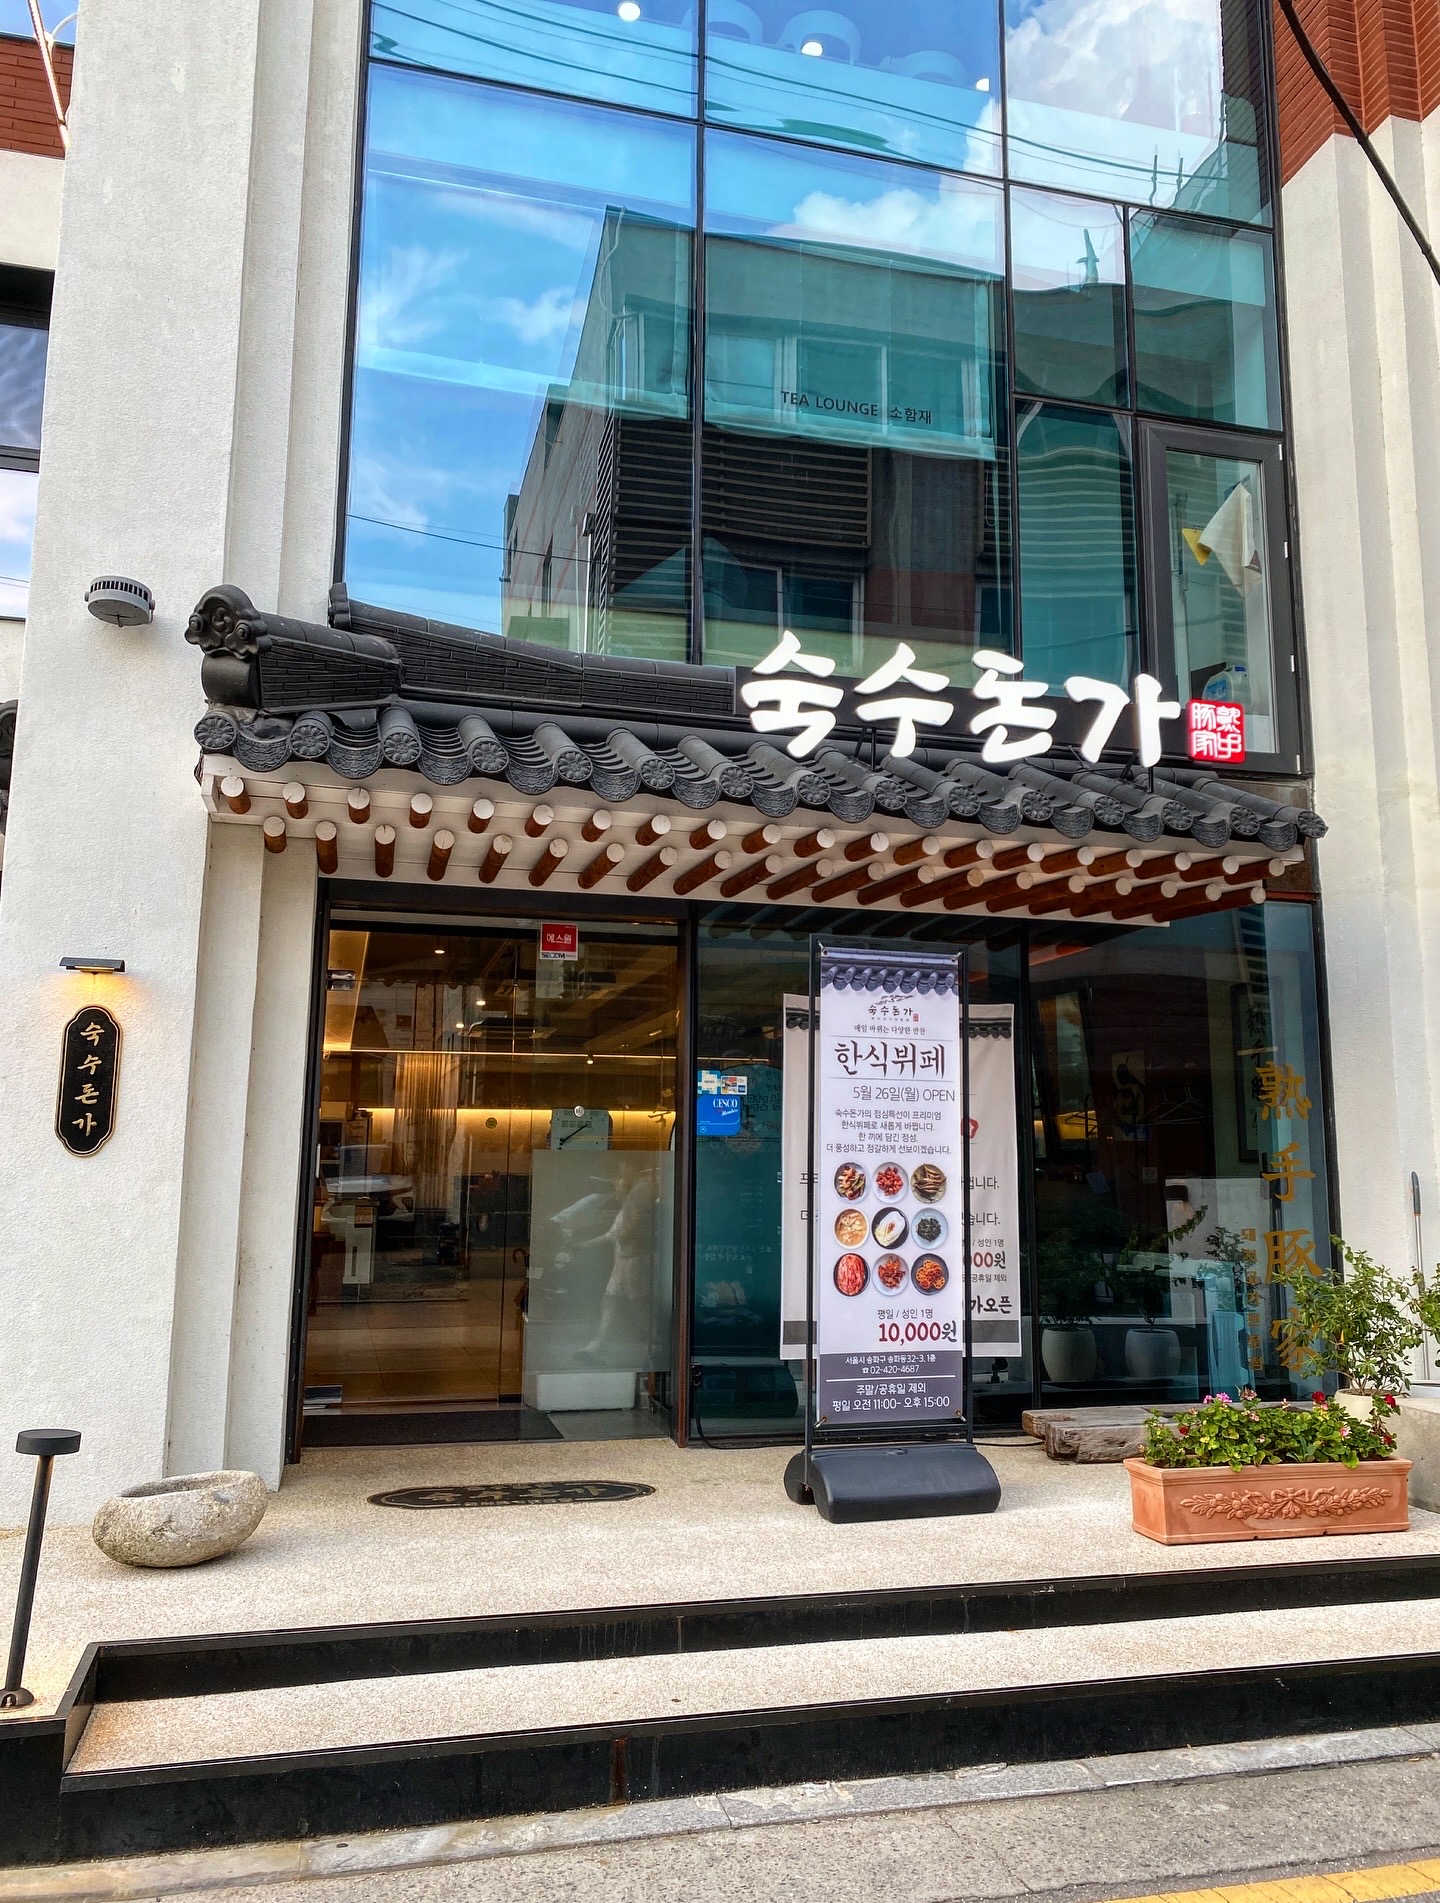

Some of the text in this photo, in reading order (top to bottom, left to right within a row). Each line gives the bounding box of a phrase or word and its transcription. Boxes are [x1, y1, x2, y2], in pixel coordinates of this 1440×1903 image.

[781, 390, 932, 425] TEA LOUNGE 소함재
[741, 630, 1181, 768] 숙수돈가
[546, 933, 572, 945] 에스원
[868, 1004, 914, 1017] 숙수돈가
[854, 1024, 926, 1036] 매일 바뀌는 다양한 반찬
[833, 1039, 945, 1079] 한식뷔페
[71, 1021, 106, 1138] 숙수돈가
[853, 1085, 956, 1102] 5월 26일(월) OPEN
[712, 1098, 738, 1109] CESCO
[835, 1108, 942, 1121] 숙수돈가의 점심특선이 프리미엄
[841, 1120, 935, 1132] 한식뷔페로 새롭게 바뀝니다.
[858, 1131, 866, 1142] 한
[868, 1132, 883, 1142] 끼에
[885, 1132, 900, 1143] 담긴
[826, 1143, 952, 1155] 더 풍성하고 정갈하게 선보이겠습니다.
[977, 1238, 992, 1248] 성인
[994, 1238, 1005, 1248] 1명
[994, 1273, 1008, 1283] 제외
[877, 1309, 894, 1320] 평일
[901, 1308, 918, 1319] 성인
[921, 1308, 933, 1319] 1명
[878, 1319, 958, 1346] 10,000원
[845, 1355, 866, 1365] 서울시
[866, 1355, 886, 1365] 송파구
[869, 1364, 920, 1375] 02-420-4687
[856, 1382, 926, 1396] 주말/공휴일 제외
[832, 1400, 851, 1412] 평일
[853, 1399, 871, 1411] 오전
[903, 1397, 922, 1408] 오후
[923, 1395, 950, 1408] 15:00
